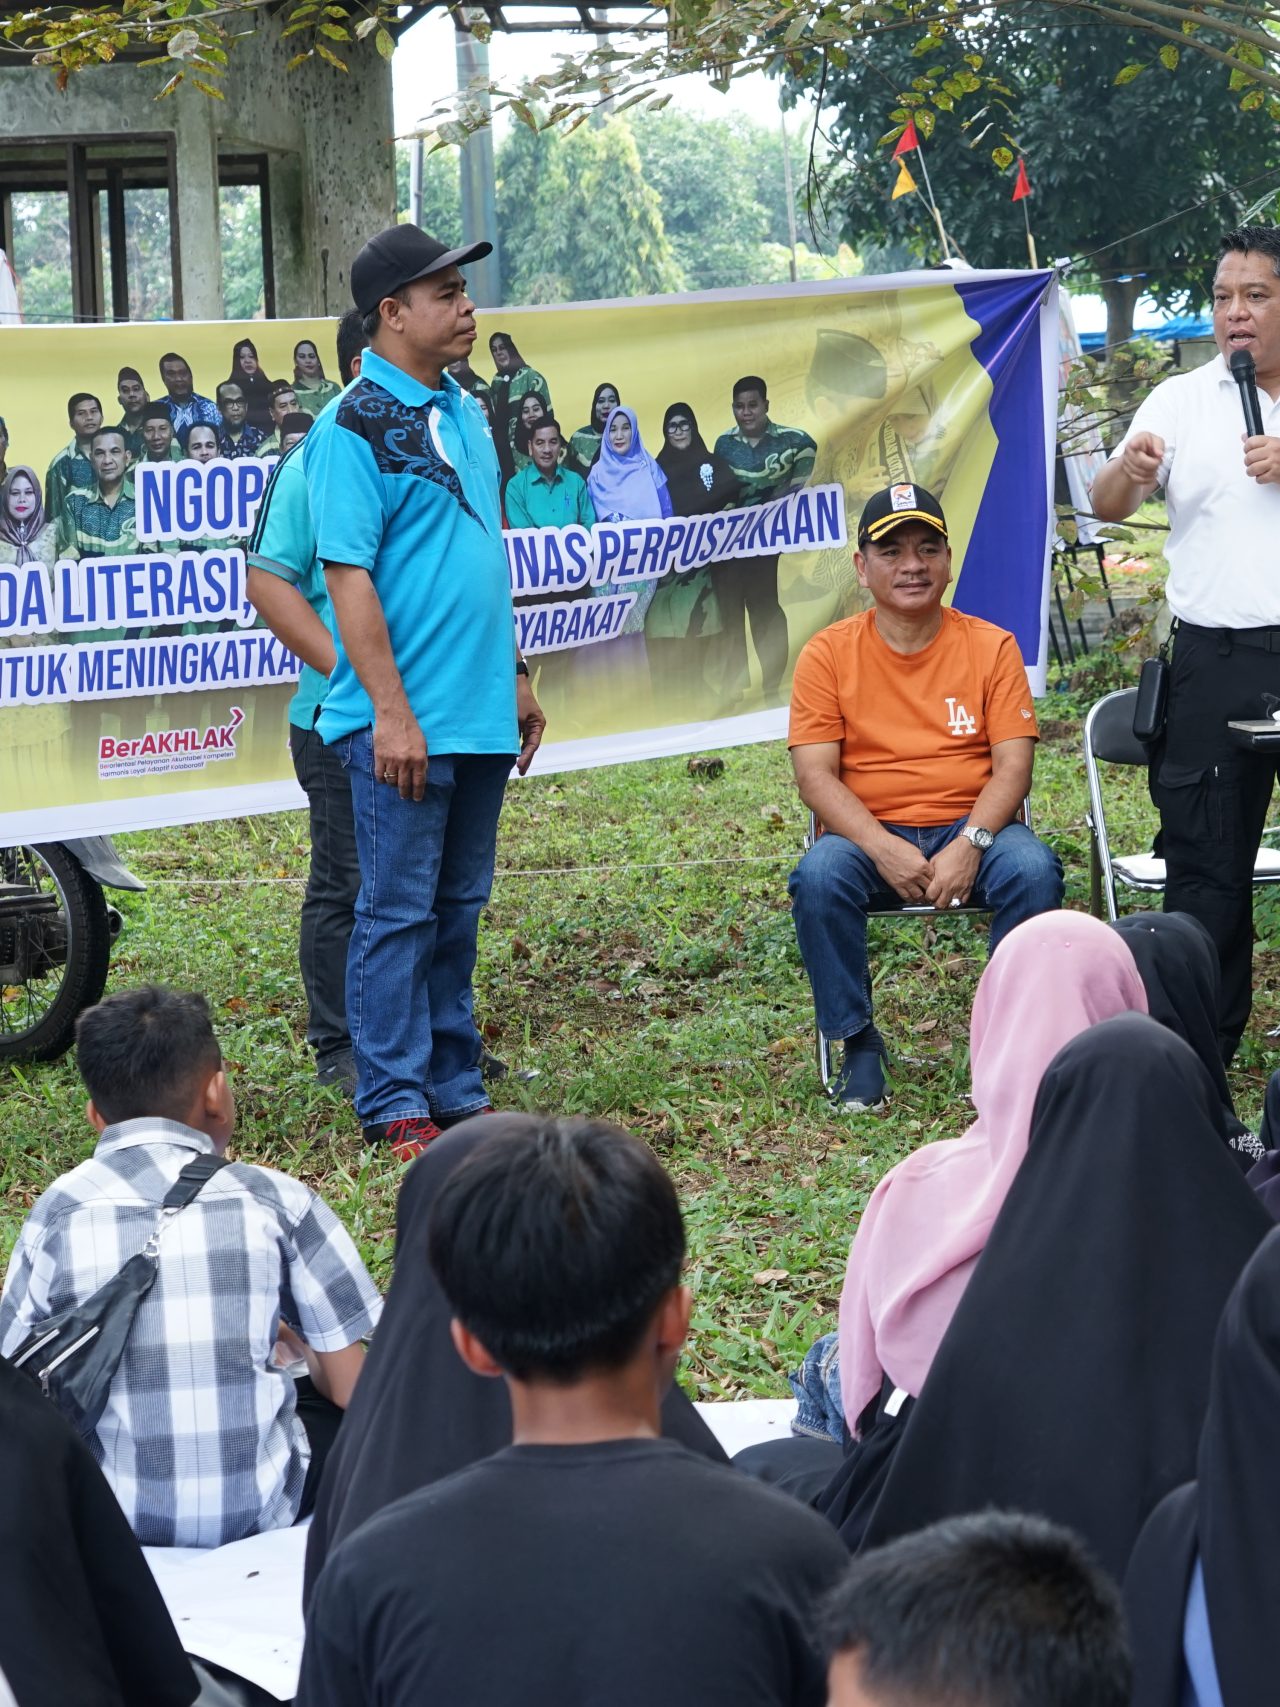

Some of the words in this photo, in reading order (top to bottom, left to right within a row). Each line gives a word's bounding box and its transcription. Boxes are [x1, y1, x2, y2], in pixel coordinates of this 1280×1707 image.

[142, 464, 276, 534] NGOP
[61, 556, 251, 624] LITERASI,
[595, 490, 841, 581] PERPUSTAKAAN
[78, 636, 305, 693] MENINGKATKA
[945, 697, 977, 736] LA
[100, 726, 235, 759] BerAKHLAK
[137, 758, 170, 768] Pelayanan
[171, 755, 202, 763] Akuntabel
[203, 751, 234, 760] Kompeten
[100, 769, 129, 778] Harmonis
